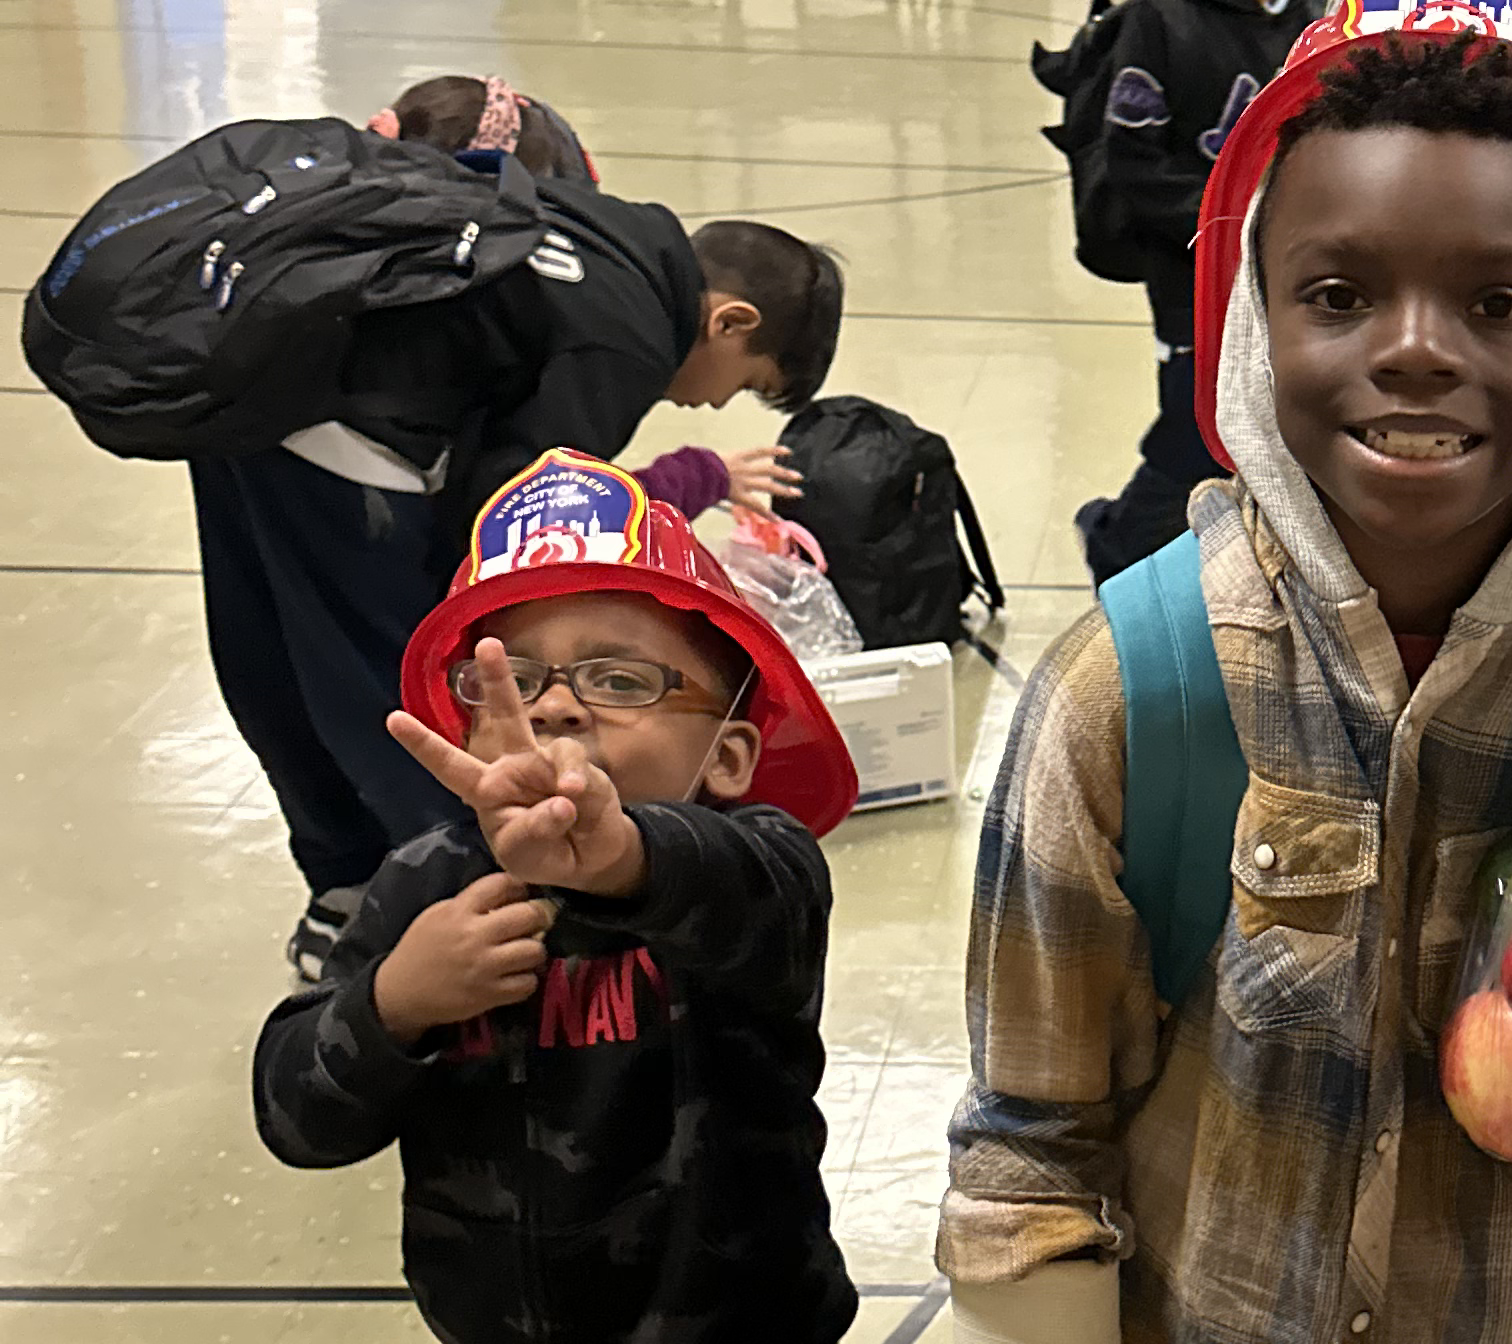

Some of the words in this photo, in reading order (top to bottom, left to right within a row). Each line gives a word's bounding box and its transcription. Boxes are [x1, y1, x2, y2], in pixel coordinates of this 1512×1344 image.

[495, 492, 522, 520] FIRE
[521, 470, 612, 497] DEPARTMENT
[512, 499, 545, 519] NEW
[547, 493, 590, 508] YORK
[523, 485, 556, 504] CITY
[556, 482, 579, 496] OF
